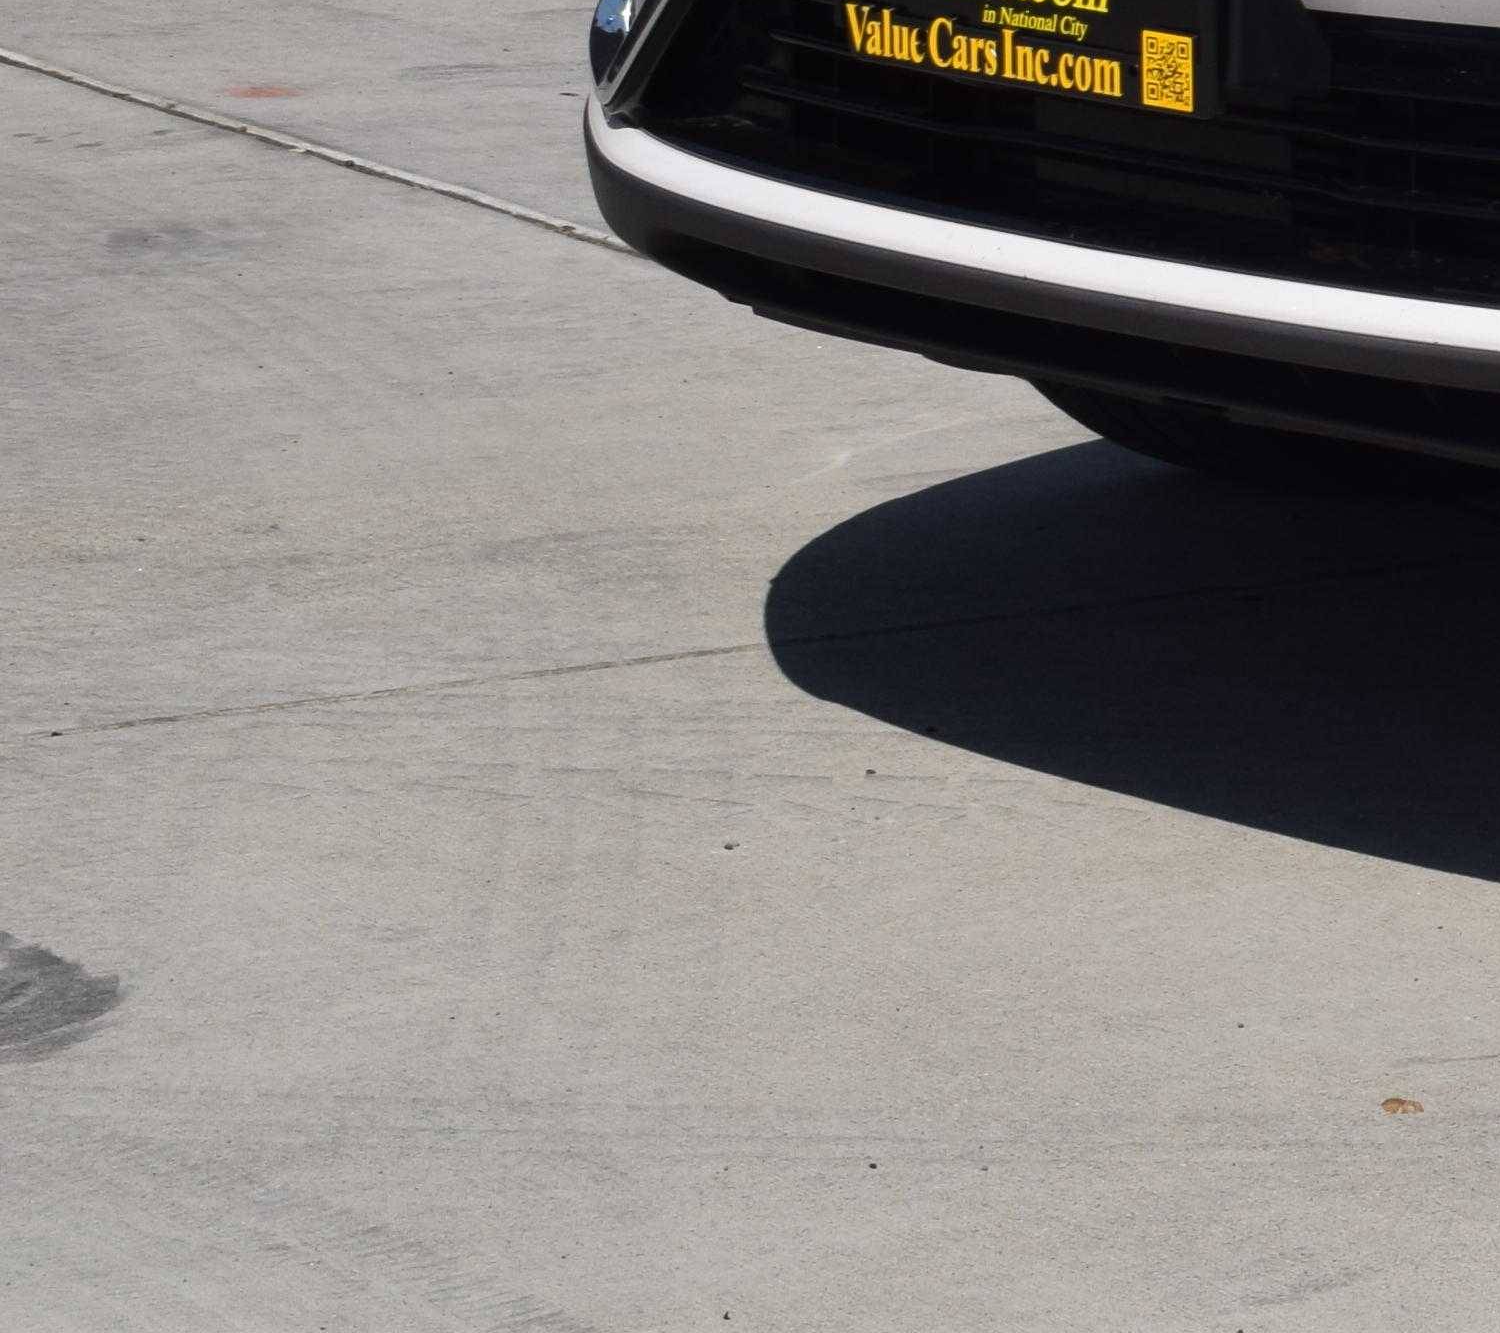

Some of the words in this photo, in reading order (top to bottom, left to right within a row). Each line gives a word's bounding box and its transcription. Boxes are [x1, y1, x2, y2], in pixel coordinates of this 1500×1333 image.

[982, 3, 996, 24] in
[999, 7, 1057, 34] National
[1060, 14, 1089, 42] City
